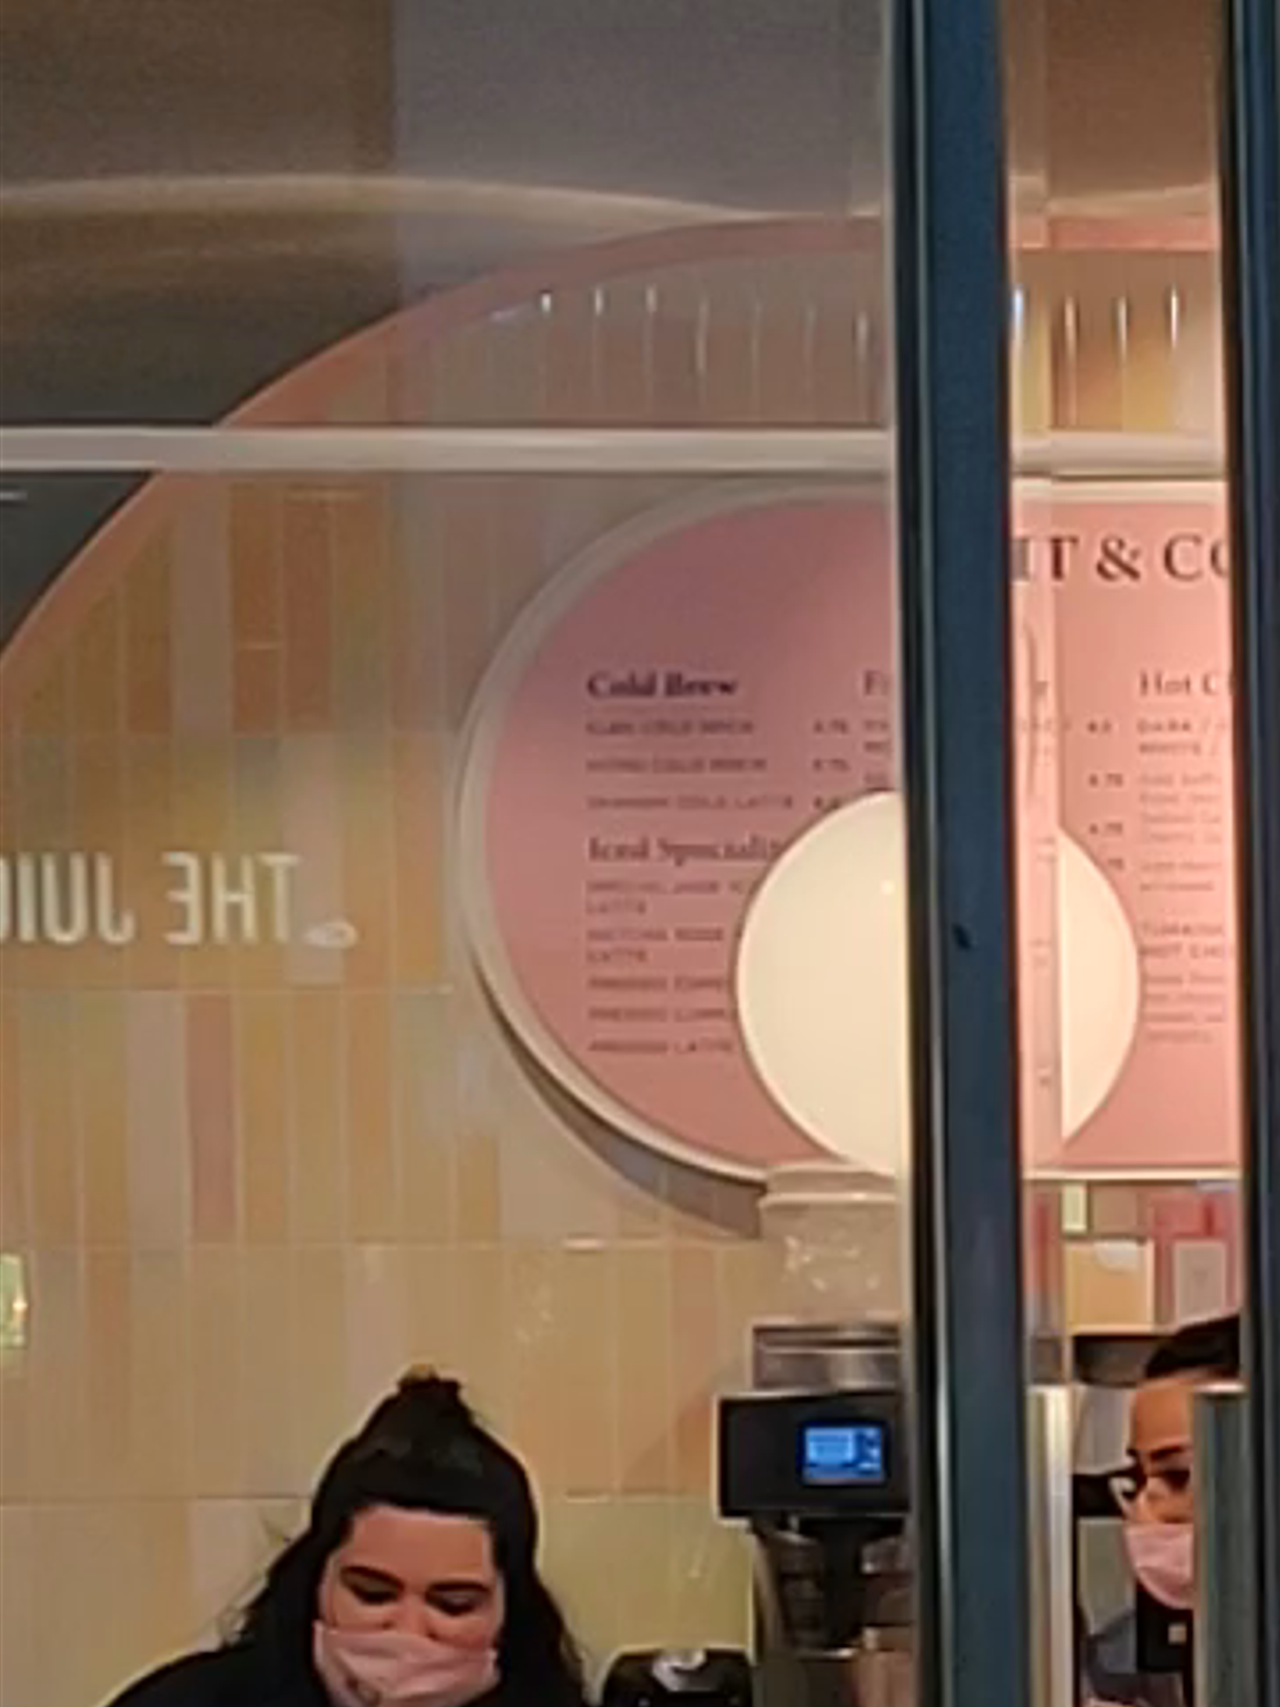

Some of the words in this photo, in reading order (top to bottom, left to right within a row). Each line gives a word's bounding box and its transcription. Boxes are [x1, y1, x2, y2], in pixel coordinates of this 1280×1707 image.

[1096, 533, 1142, 581] &
[586, 671, 656, 697] Cold
[664, 671, 738, 697] Brew
